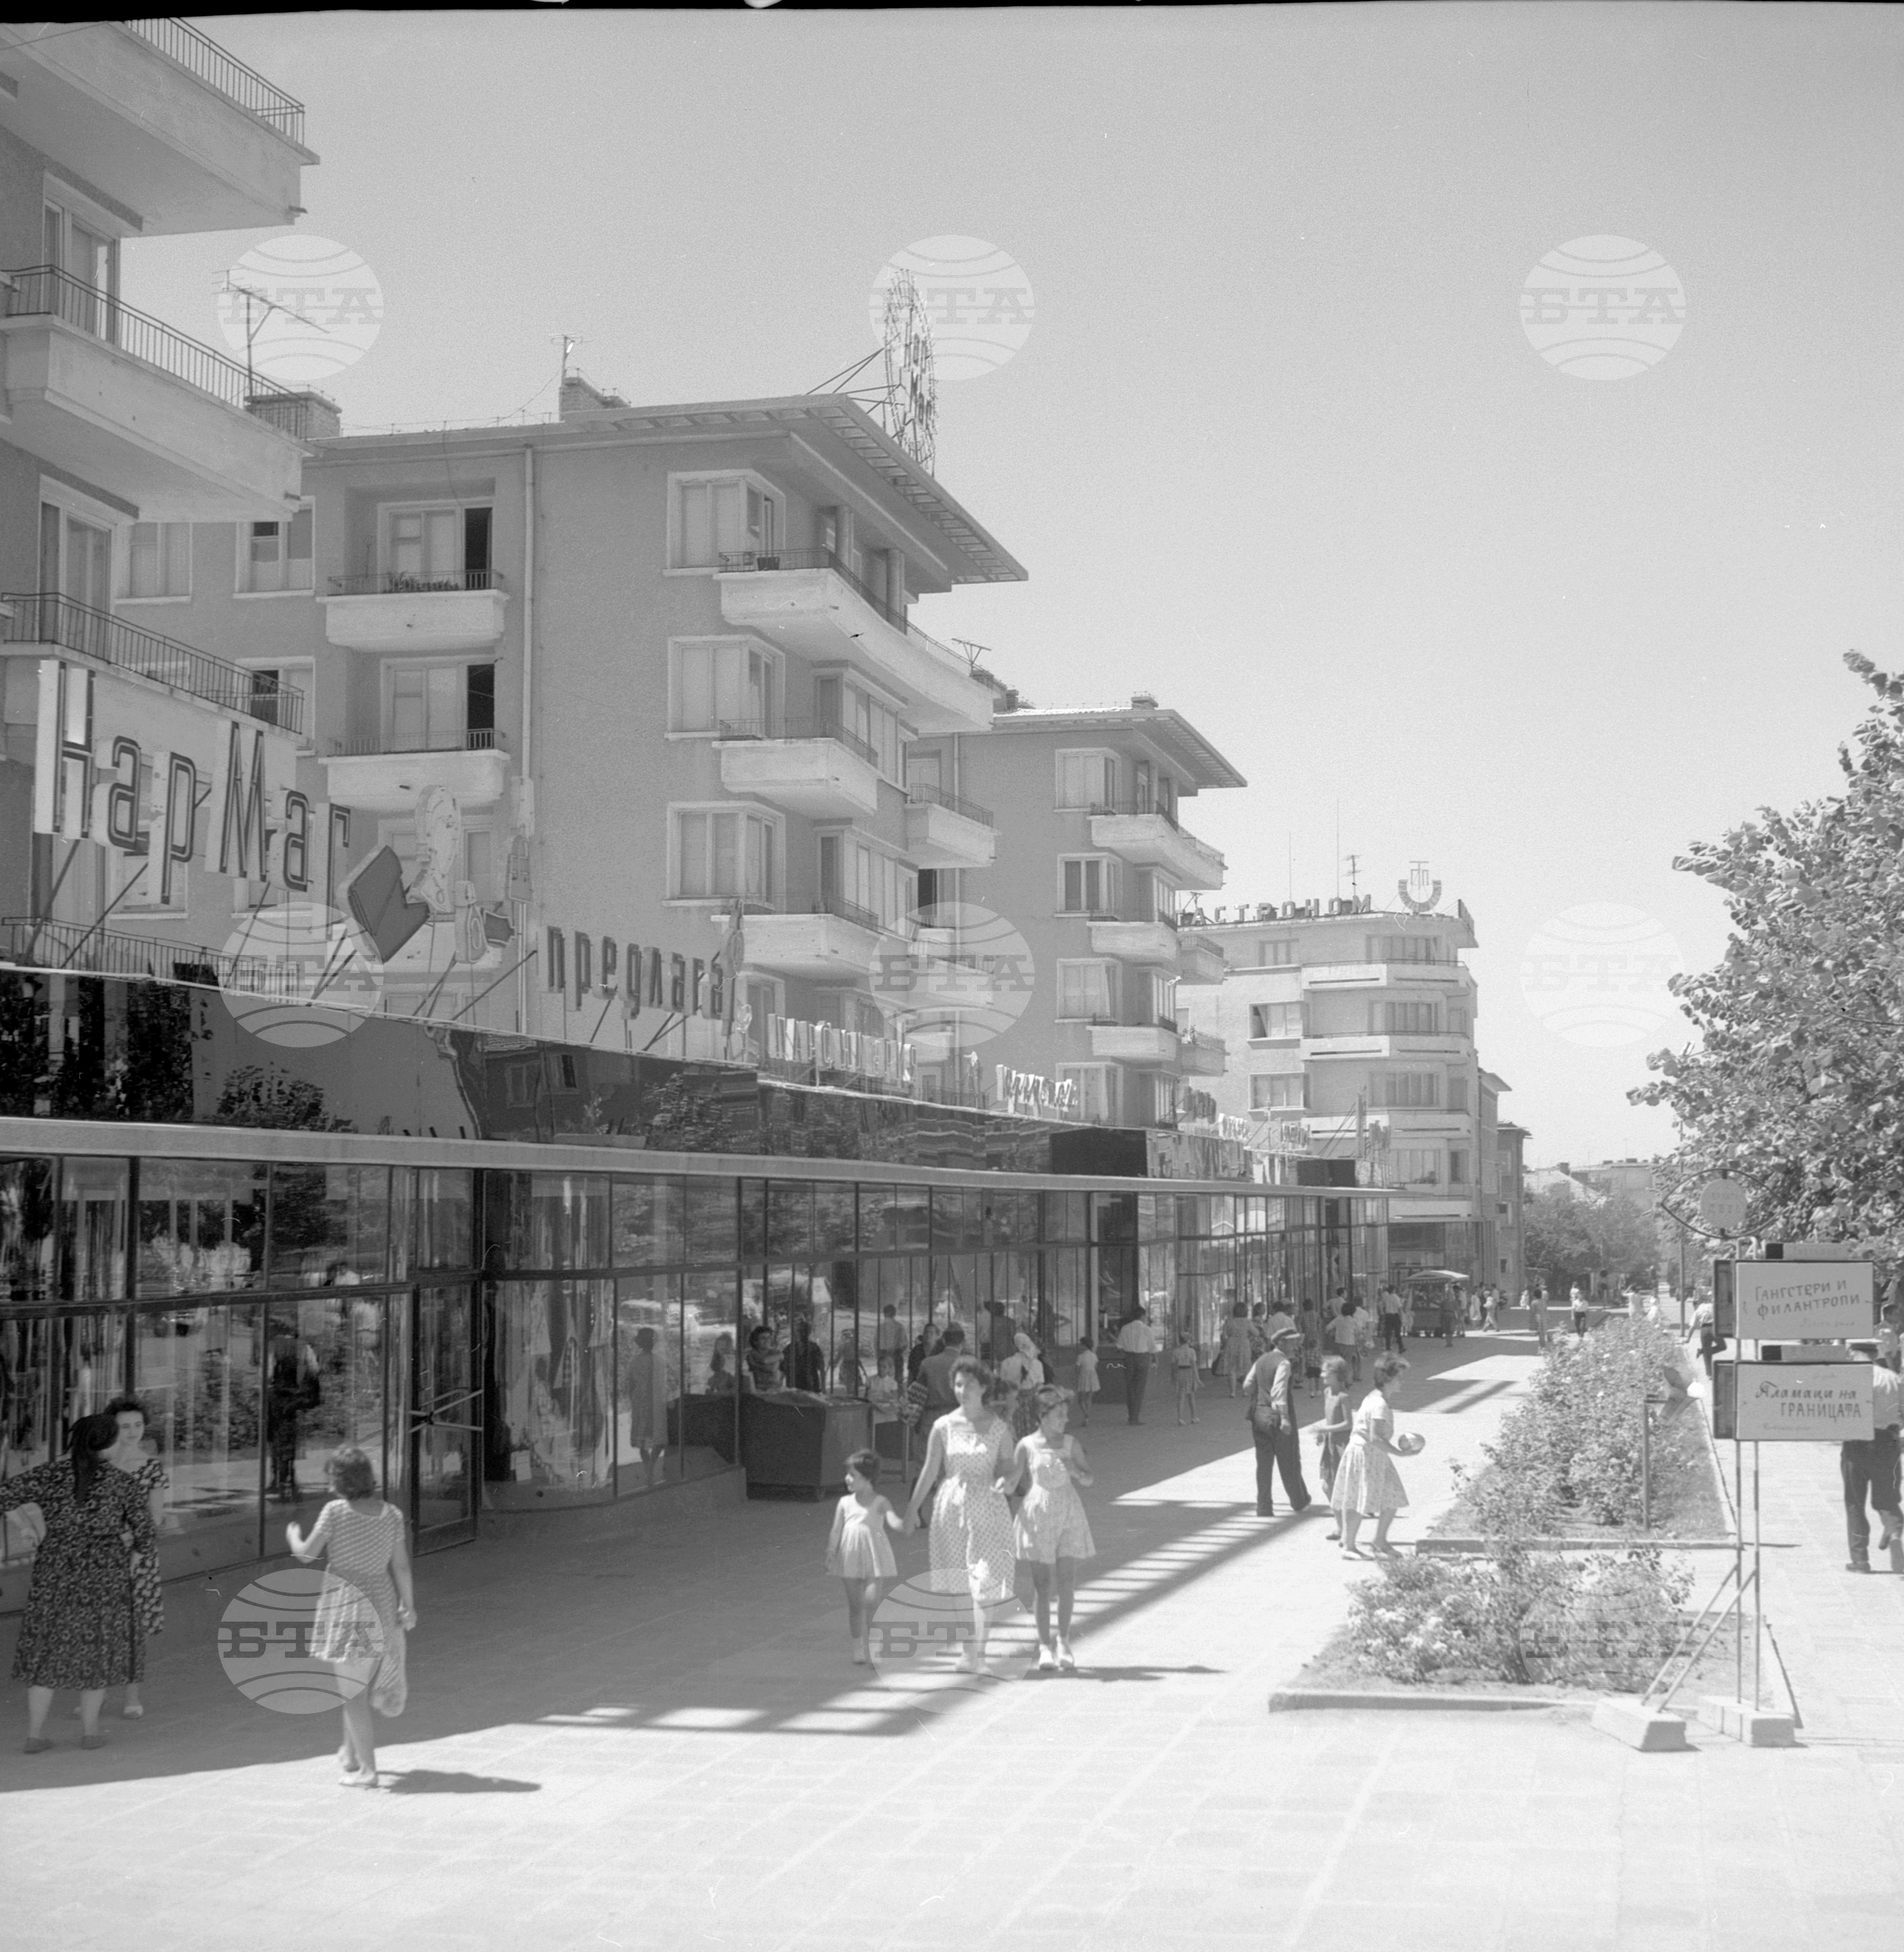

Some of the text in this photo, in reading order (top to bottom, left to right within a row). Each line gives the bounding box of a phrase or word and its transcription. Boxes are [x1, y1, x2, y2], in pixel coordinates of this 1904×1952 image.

[1175, 894, 1372, 926] ГАСТРОНОМ
[1839, 1389, 1857, 1400] на
[1780, 1402, 1862, 1423] ГРАНИЦАТА
